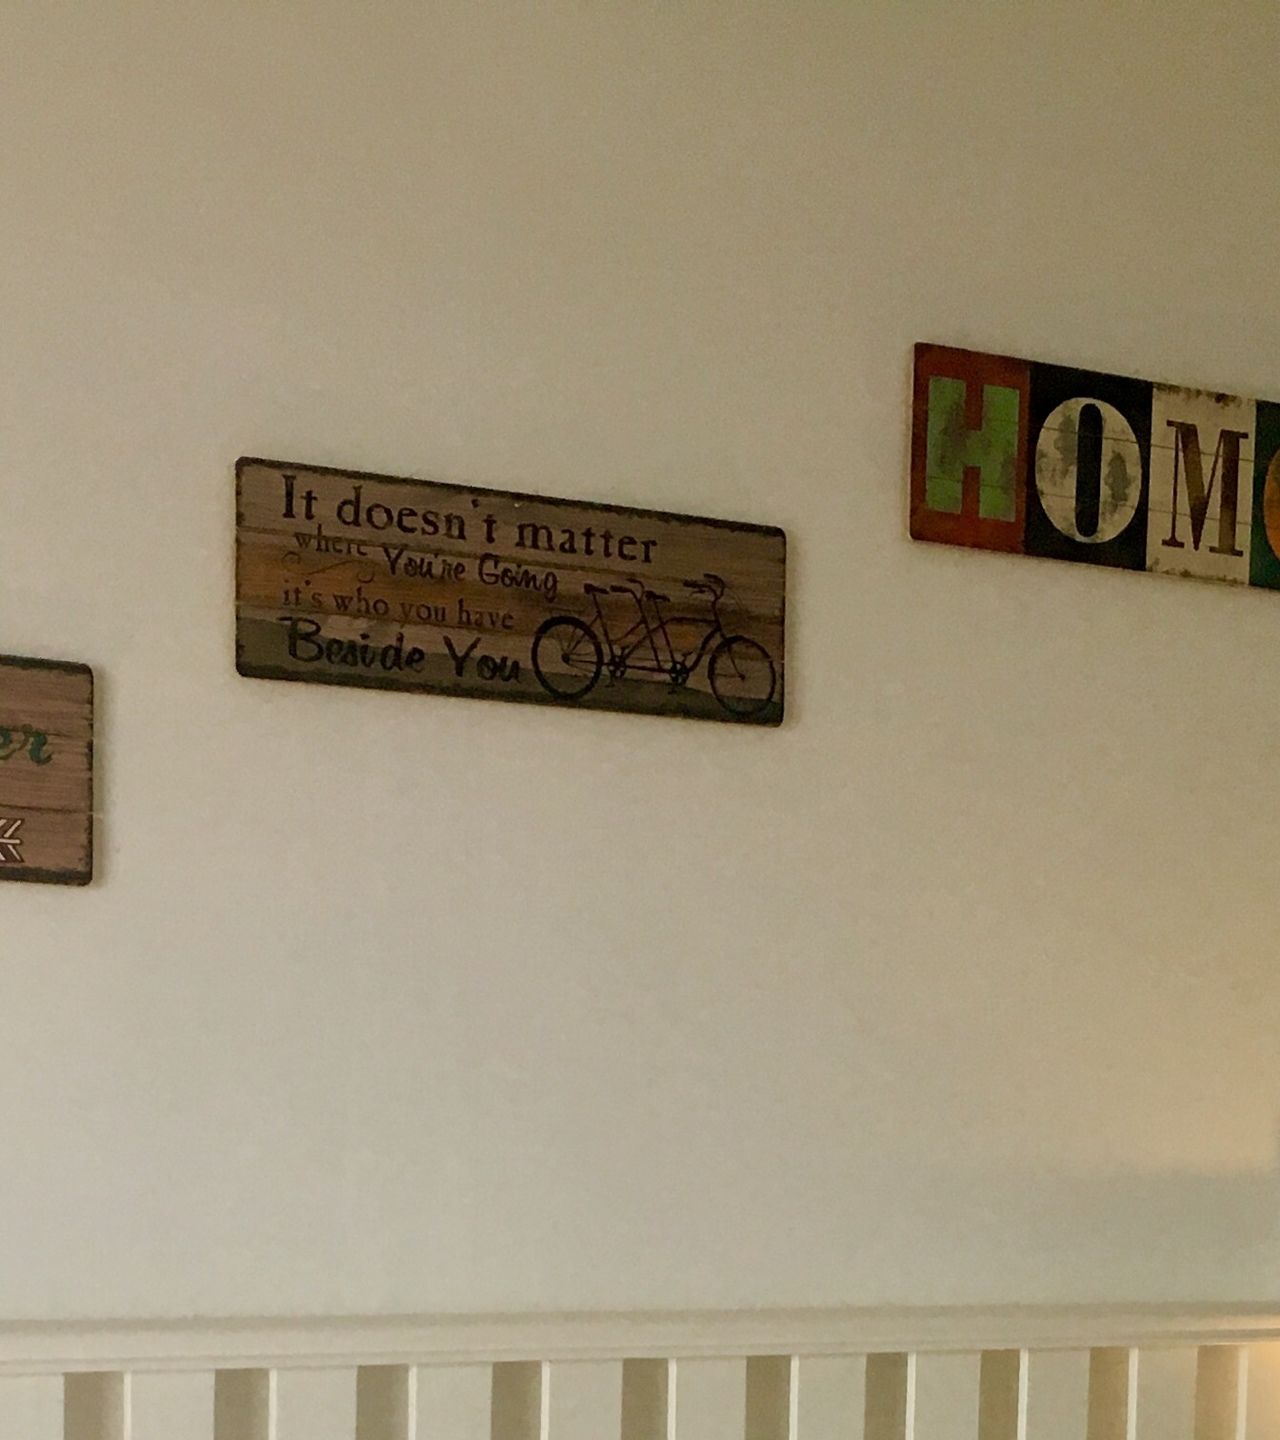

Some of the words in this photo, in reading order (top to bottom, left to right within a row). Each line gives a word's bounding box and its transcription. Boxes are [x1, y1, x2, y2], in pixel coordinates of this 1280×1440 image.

[281, 473, 318, 521] It
[336, 484, 498, 545] doesn't
[515, 521, 659, 565] matter
[294, 522, 368, 557] where
[381, 543, 466, 583] You're
[477, 551, 559, 603] Going
[282, 579, 323, 607] it's
[332, 585, 390, 617] who
[399, 600, 448, 630] you
[457, 597, 516, 631] have
[277, 615, 426, 674] Beside
[442, 634, 521, 683] You
